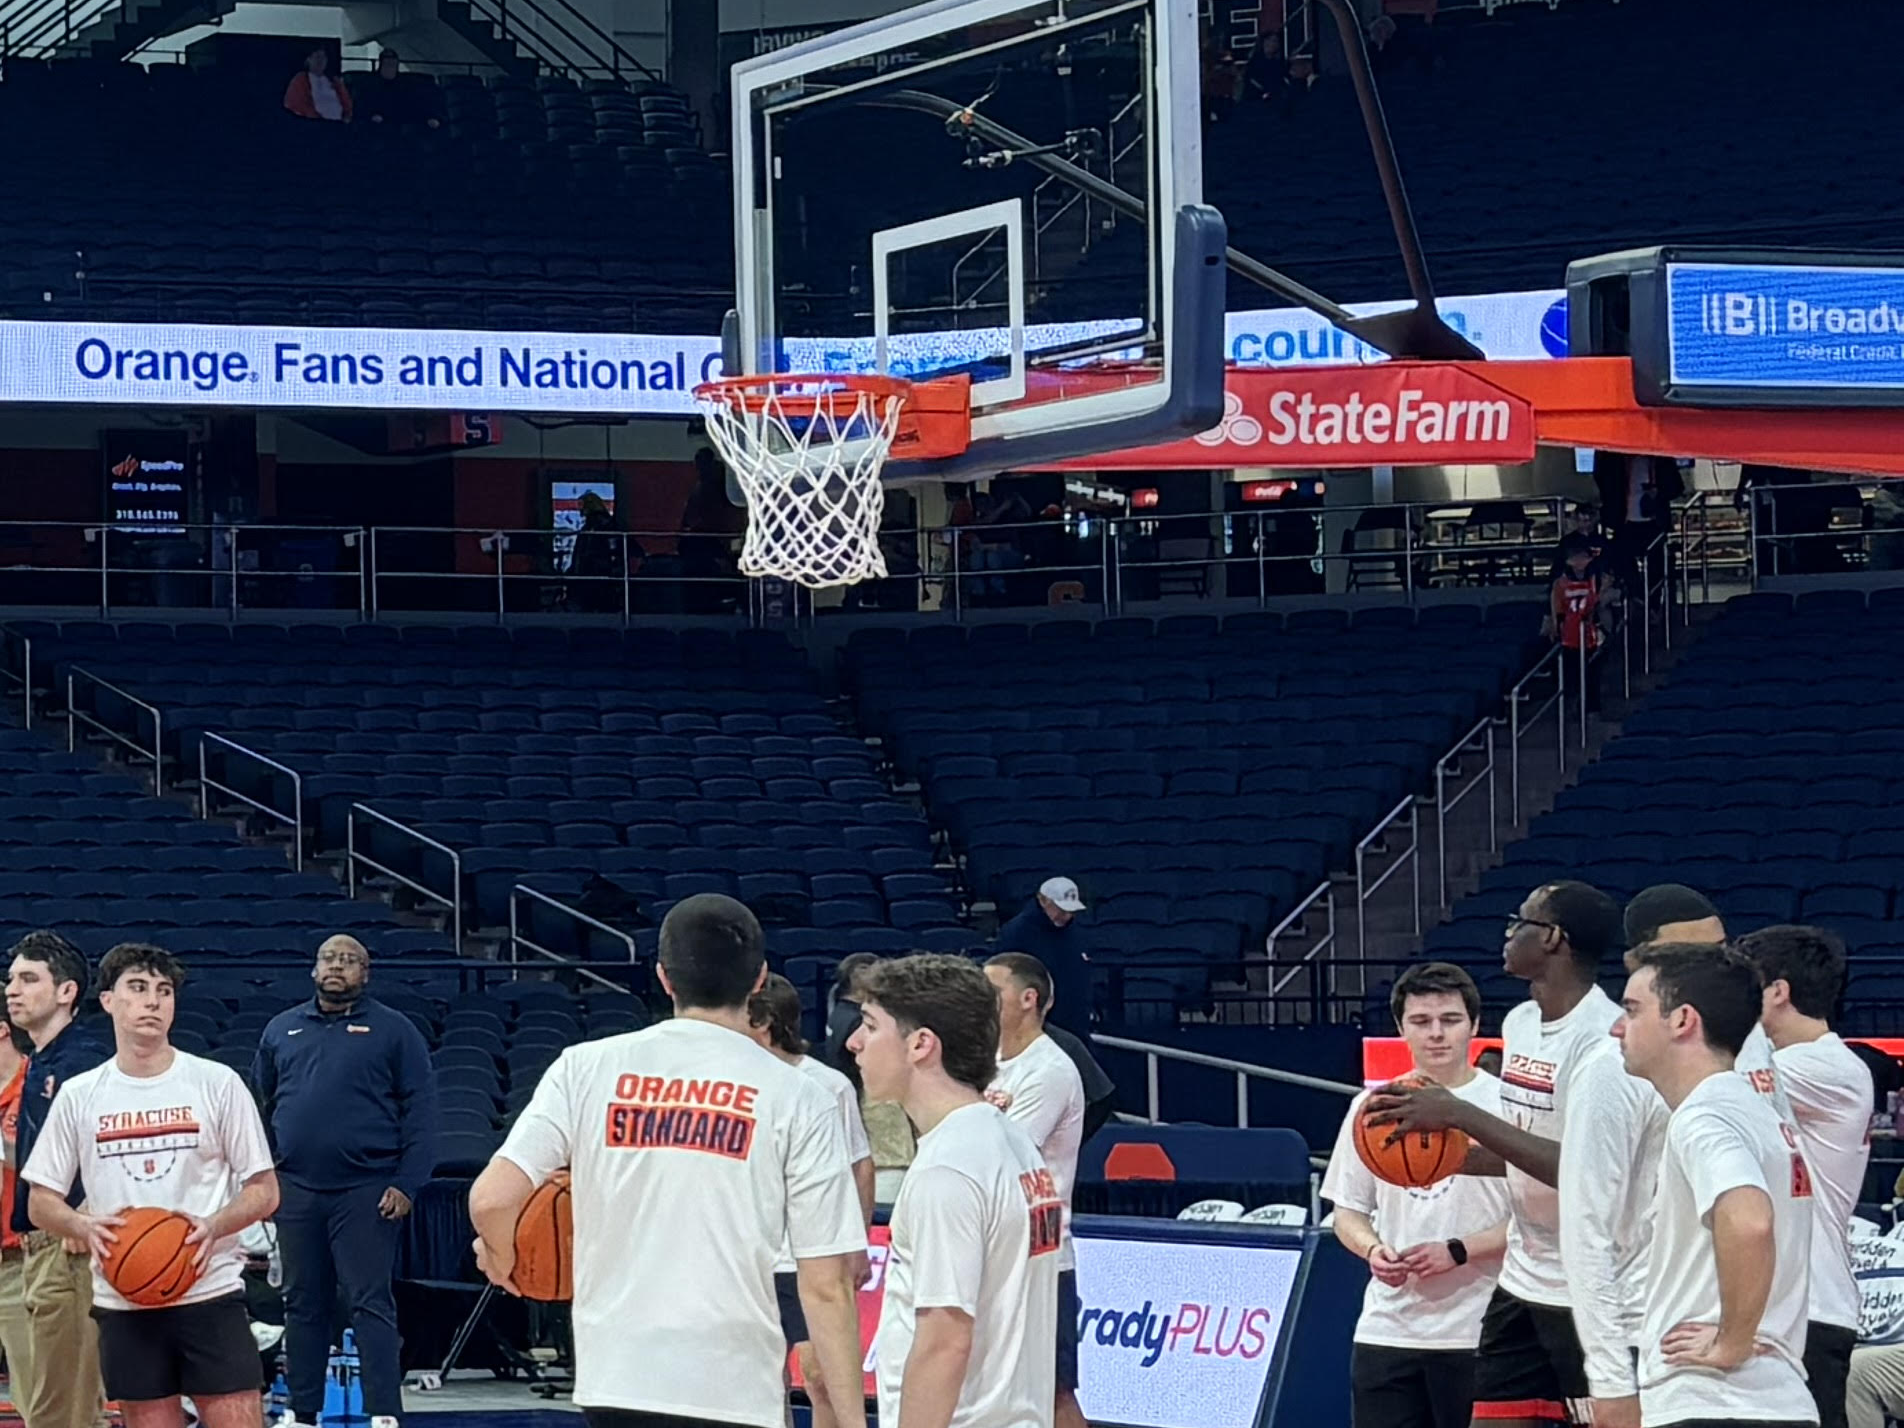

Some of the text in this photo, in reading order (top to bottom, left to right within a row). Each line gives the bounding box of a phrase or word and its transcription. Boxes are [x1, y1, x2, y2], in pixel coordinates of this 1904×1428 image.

[273, 343, 385, 387] Fans
[398, 344, 483, 389] and
[498, 352, 687, 392] National
[1266, 387, 1511, 444] StateFarm
[615, 1073, 758, 1114] ORANGE
[98, 1106, 192, 1131] SYRACUSE
[607, 1106, 755, 1158] STANDARD
